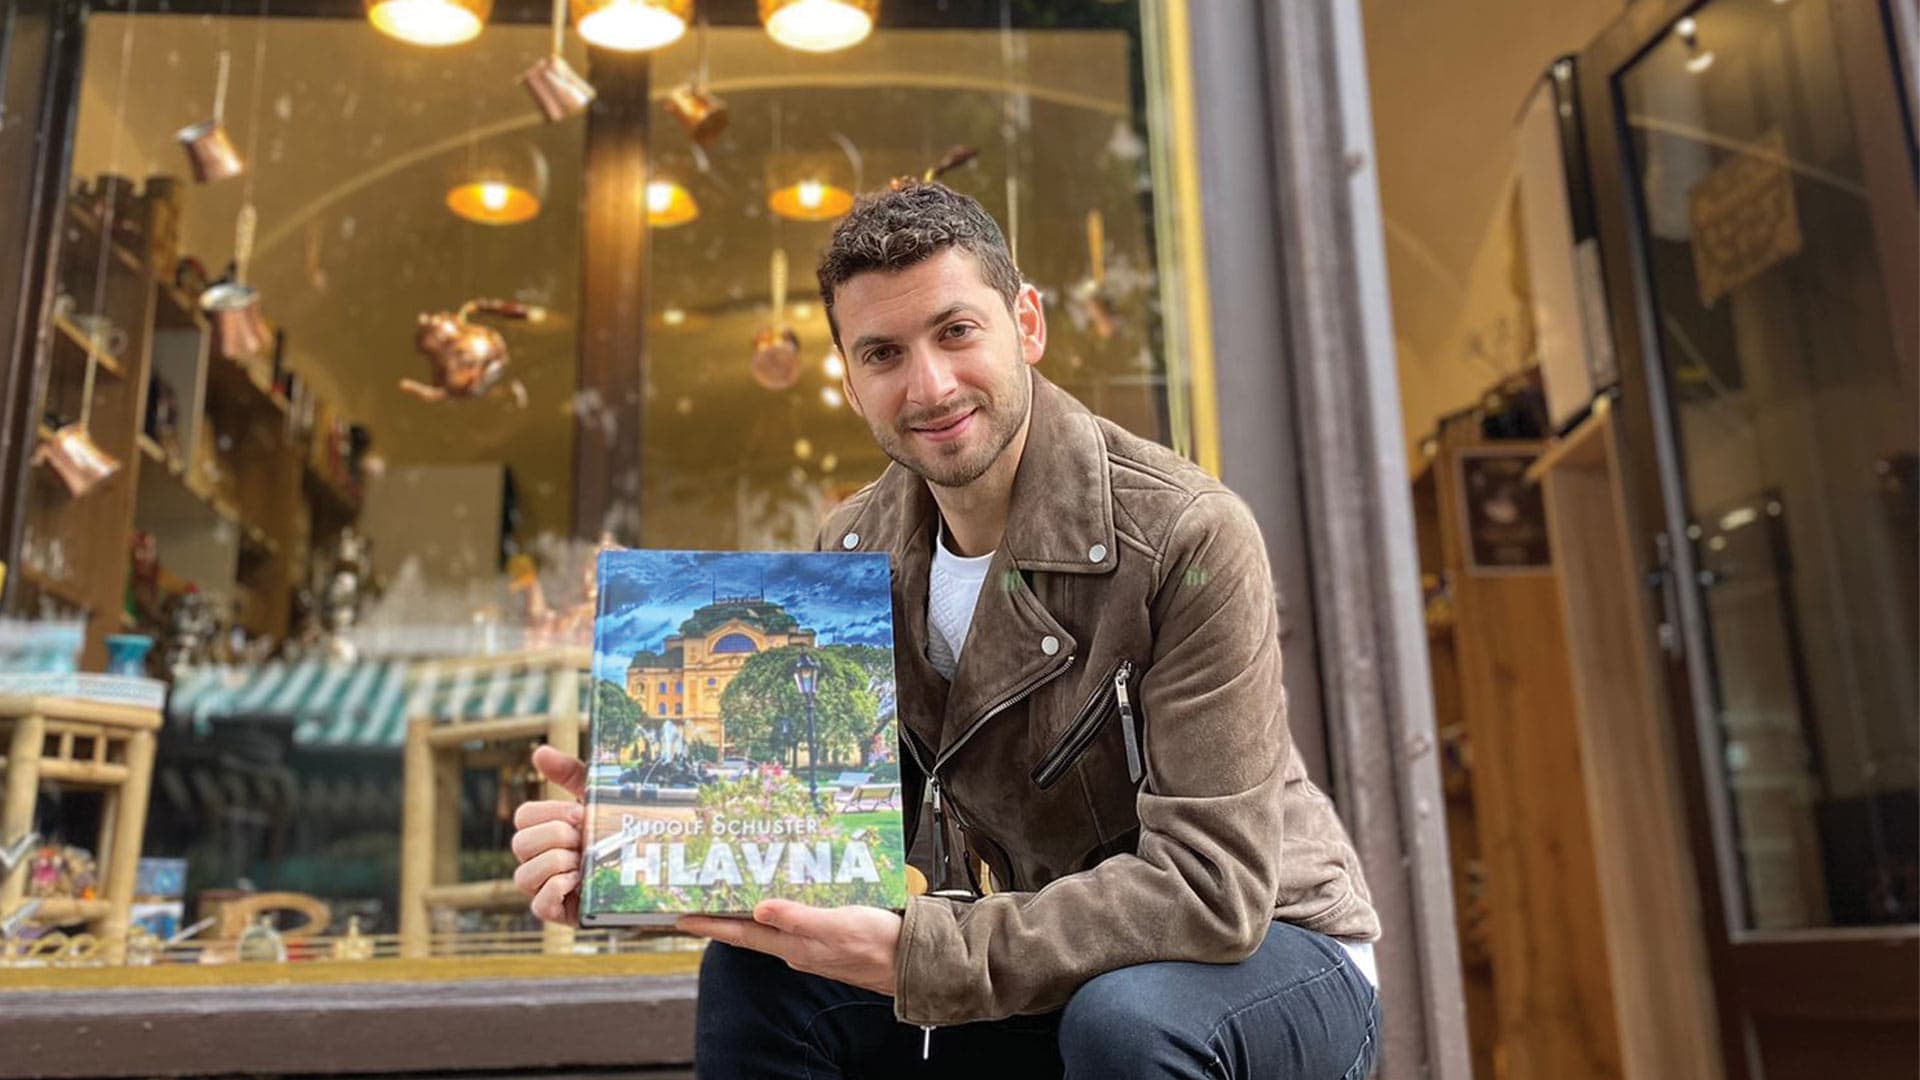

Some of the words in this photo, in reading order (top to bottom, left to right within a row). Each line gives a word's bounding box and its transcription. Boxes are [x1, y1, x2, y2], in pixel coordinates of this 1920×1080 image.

[622, 814, 705, 836] RUDOLF
[712, 814, 817, 836] SCHUSTER
[620, 828, 881, 886] HLAVNÁ
